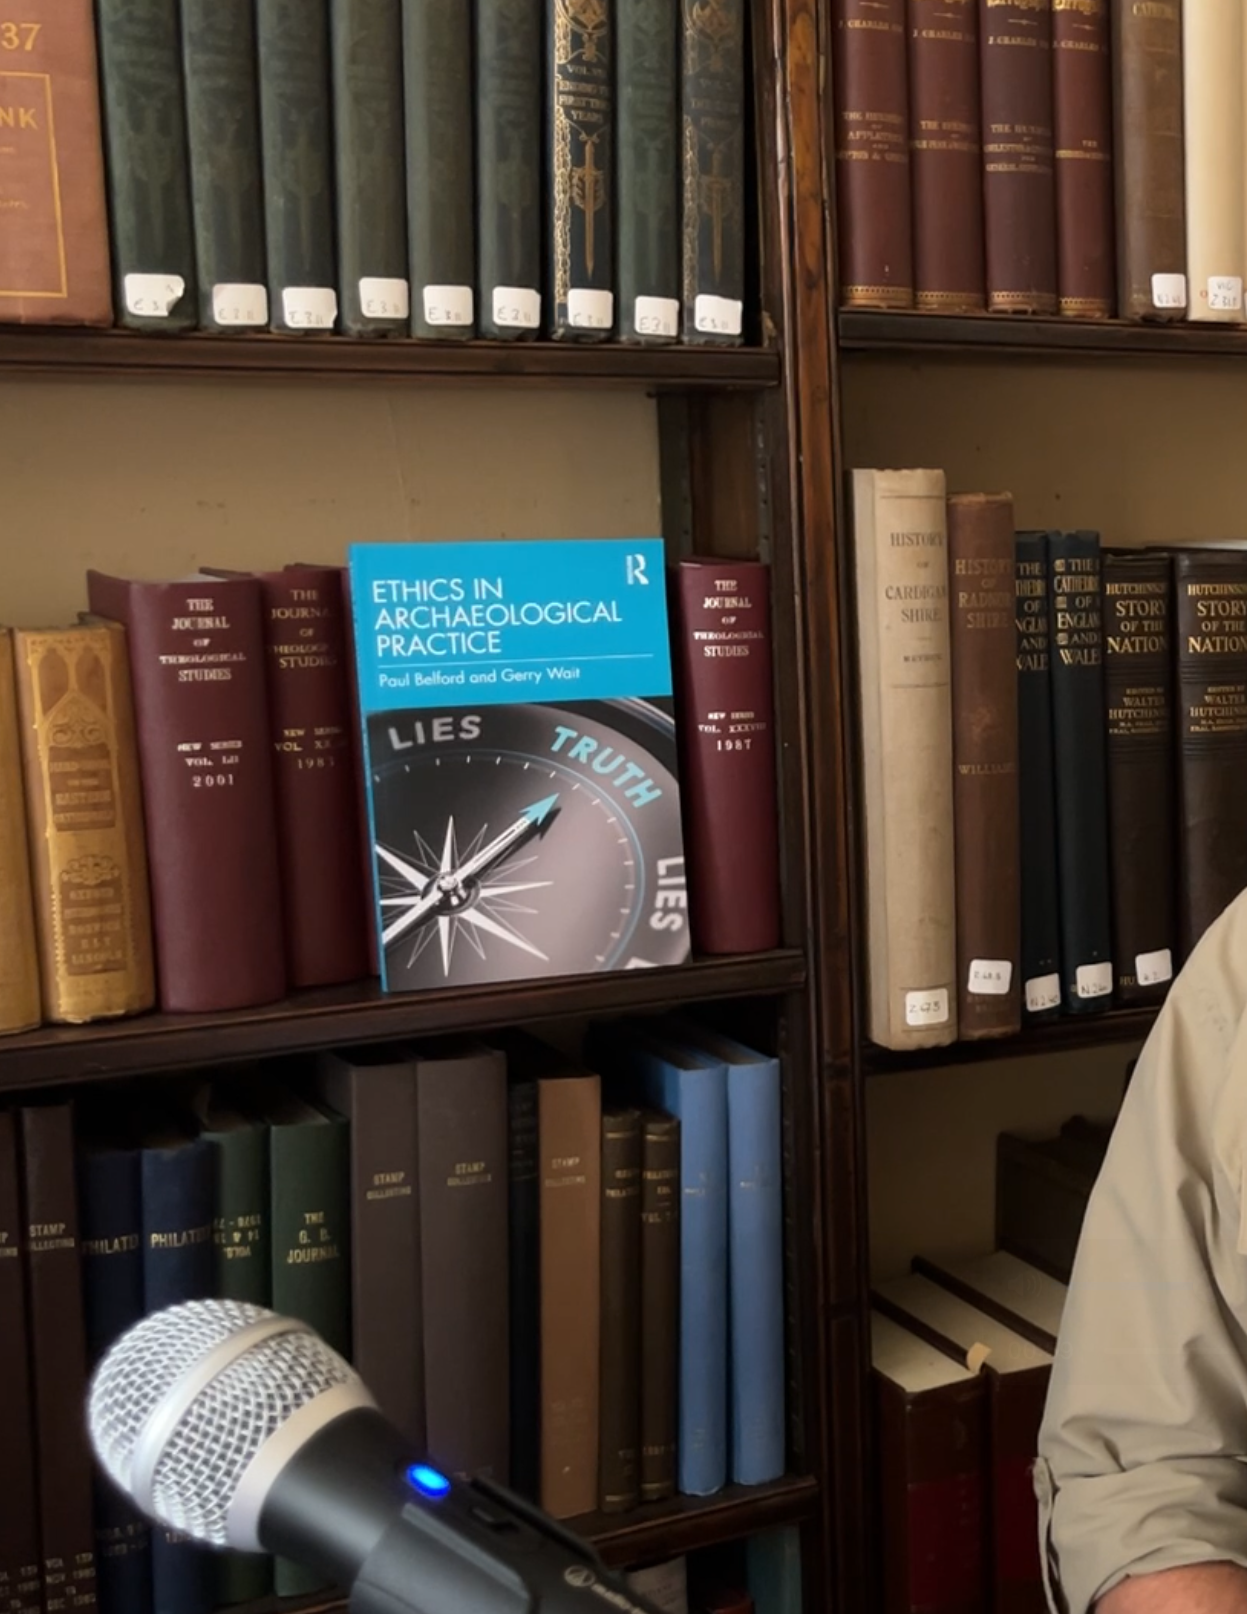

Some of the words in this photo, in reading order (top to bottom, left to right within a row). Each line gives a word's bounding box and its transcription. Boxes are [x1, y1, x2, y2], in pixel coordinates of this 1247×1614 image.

[890, 532, 943, 547] HISTORY
[955, 559, 1010, 574] HISTORY
[1019, 562, 1041, 576] THE
[1071, 558, 1094, 572] THE
[372, 578, 465, 604] ETHICS
[474, 577, 503, 600] IN
[714, 580, 737, 591] THE
[187, 599, 214, 611] THE
[703, 597, 752, 608] JOURNAL
[1024, 601, 1041, 613] OF
[1075, 596, 1093, 608] OF
[1116, 600, 1166, 617] STORY
[1197, 599, 1247, 617] STORY
[374, 600, 622, 631] ARCHAEOLOGICAL
[721, 616, 736, 624] OF
[901, 608, 942, 623] SHIRE
[967, 612, 1009, 628] SHIRE
[172, 616, 230, 630] JOURNAL
[1120, 621, 1136, 632] OF
[1142, 620, 1164, 631] THE
[1201, 621, 1219, 633] OF
[1223, 620, 1246, 632] THE
[193, 638, 211, 648] OF
[1071, 629, 1097, 644] AND
[377, 631, 502, 658] PRACTICE
[704, 645, 749, 657] STUDIES
[159, 653, 246, 665] THEOLOGICAL
[178, 669, 232, 682] STUDIES
[379, 673, 410, 688] Paul
[415, 670, 465, 687] Belford
[470, 670, 497, 684] and
[501, 668, 542, 685] Gerry
[547, 667, 580, 680] Wait
[388, 715, 482, 751] LIES
[716, 739, 752, 751] 1987
[550, 725, 663, 809] TRUTH
[192, 774, 235, 788] 2001
[650, 856, 687, 933] LIES
[455, 1160, 486, 1175] STAMP
[373, 1170, 405, 1186] STAMP
[304, 1211, 324, 1225] THE
[29, 1222, 66, 1238] STAMP
[286, 1244, 340, 1264] JOURNAL
